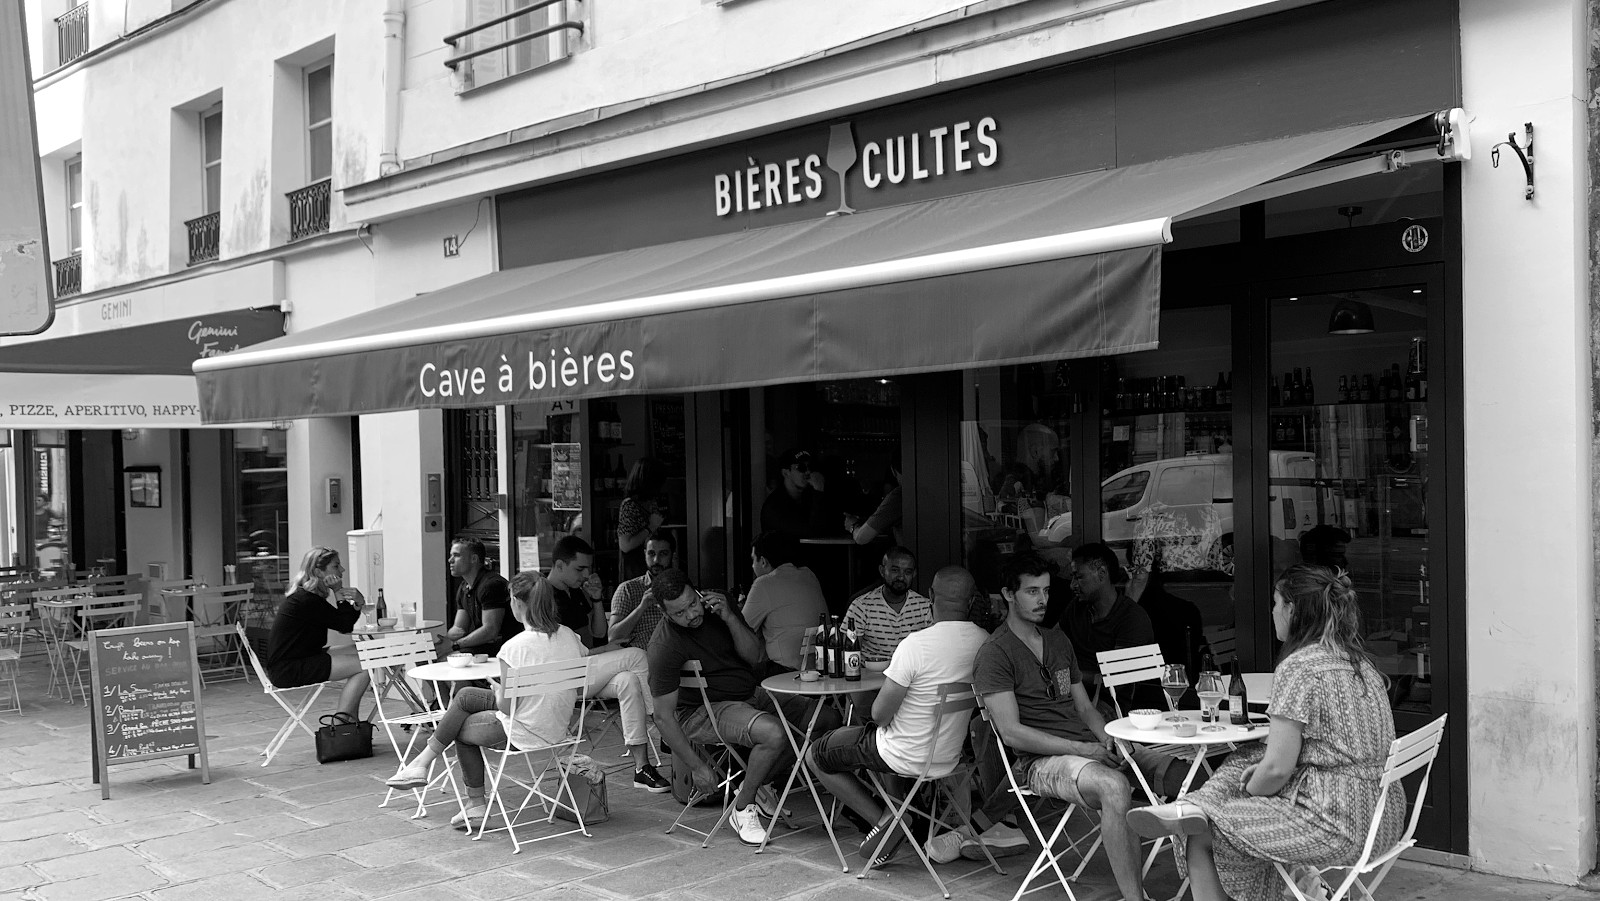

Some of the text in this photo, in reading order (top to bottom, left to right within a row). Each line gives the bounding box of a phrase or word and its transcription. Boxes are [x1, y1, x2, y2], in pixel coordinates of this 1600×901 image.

[714, 116, 998, 216] BIÈRES CULTES
[444, 237, 458, 257] 14
[101, 299, 132, 320] GEMINI
[188, 321, 238, 344] Gemini
[419, 347, 635, 397] Cave à bières
[9, 404, 58, 417] PIZZE,
[64, 404, 147, 417] APERITIVO,
